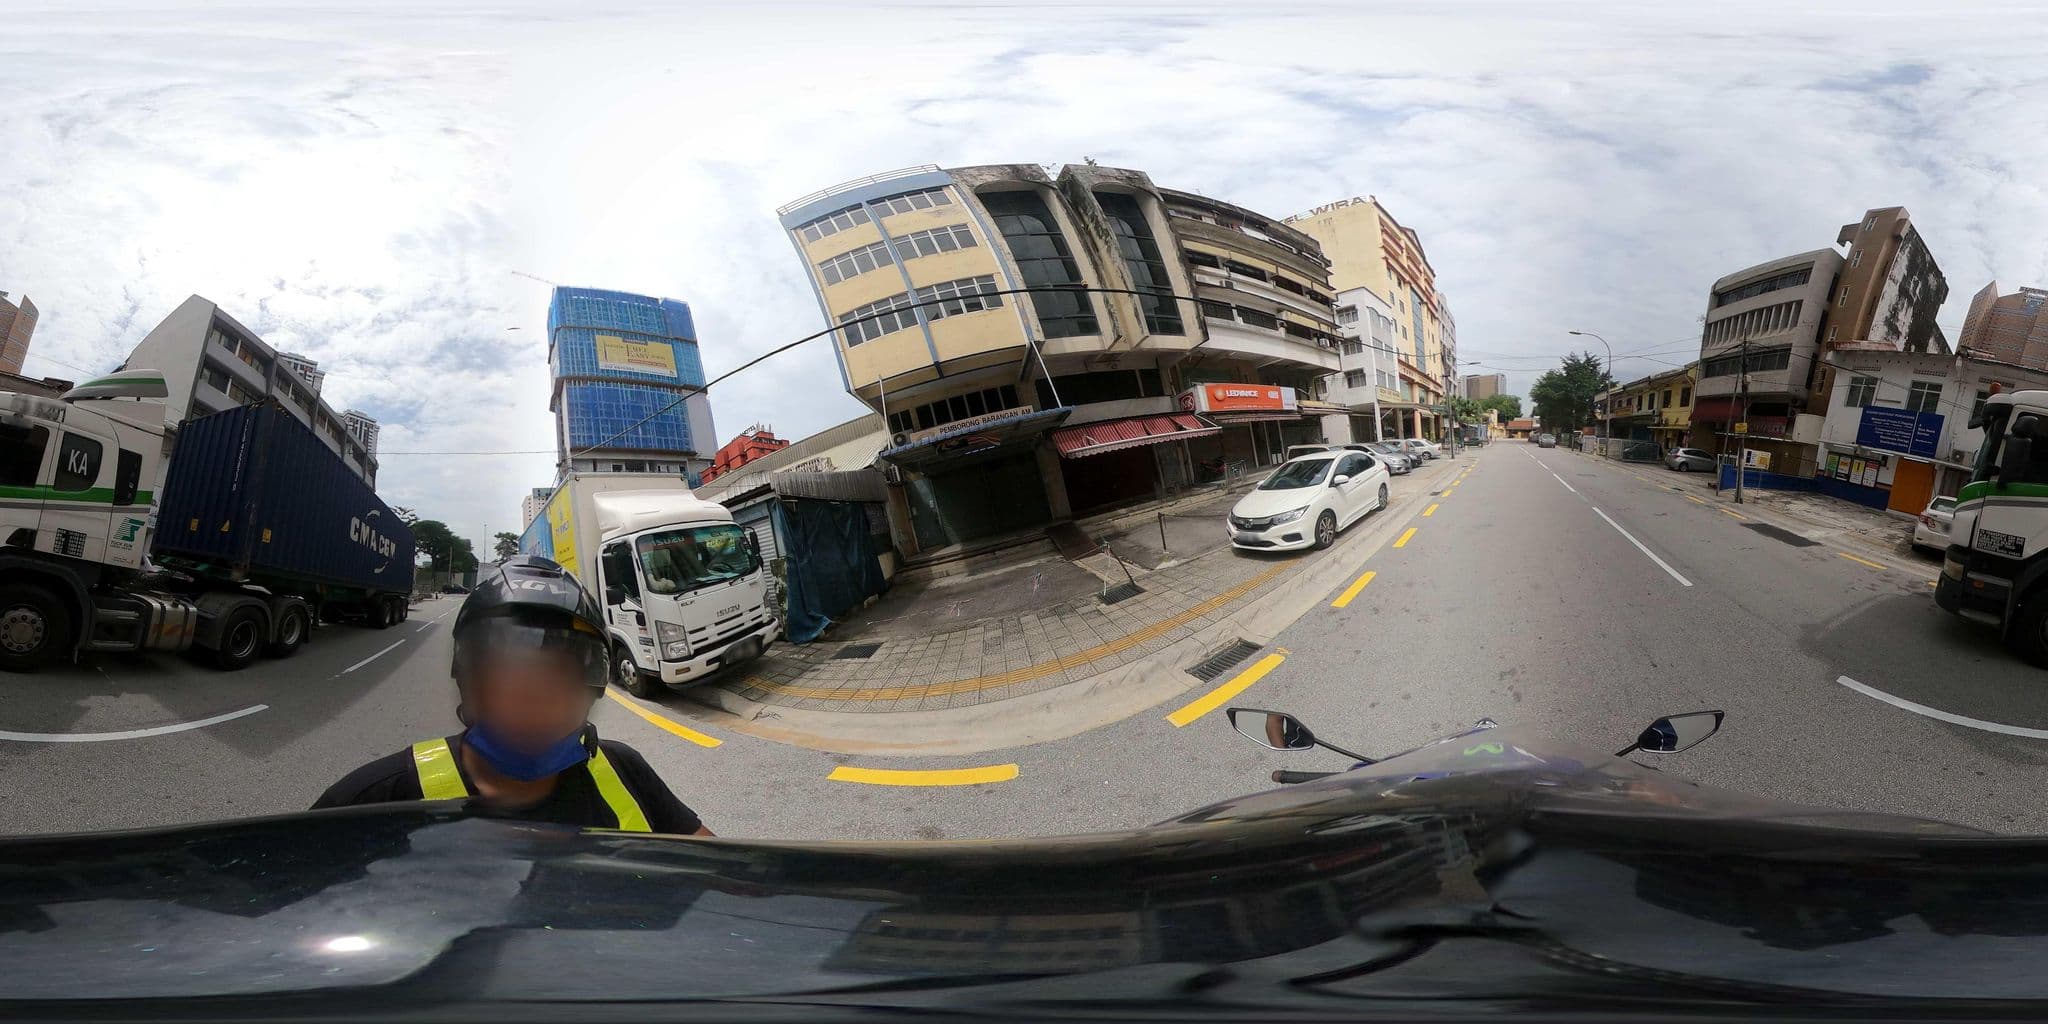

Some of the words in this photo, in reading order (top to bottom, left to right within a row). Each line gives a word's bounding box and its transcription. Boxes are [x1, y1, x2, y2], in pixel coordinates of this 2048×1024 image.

[1310, 197, 1366, 216] WIRA
[939, 417, 980, 434] PEMBORONG
[982, 411, 1018, 424] BARANGAN
[68, 449, 88, 475] KA
[350, 516, 377, 551] CMA
[379, 534, 396, 560] CGM
[717, 604, 740, 617] ISUZU
